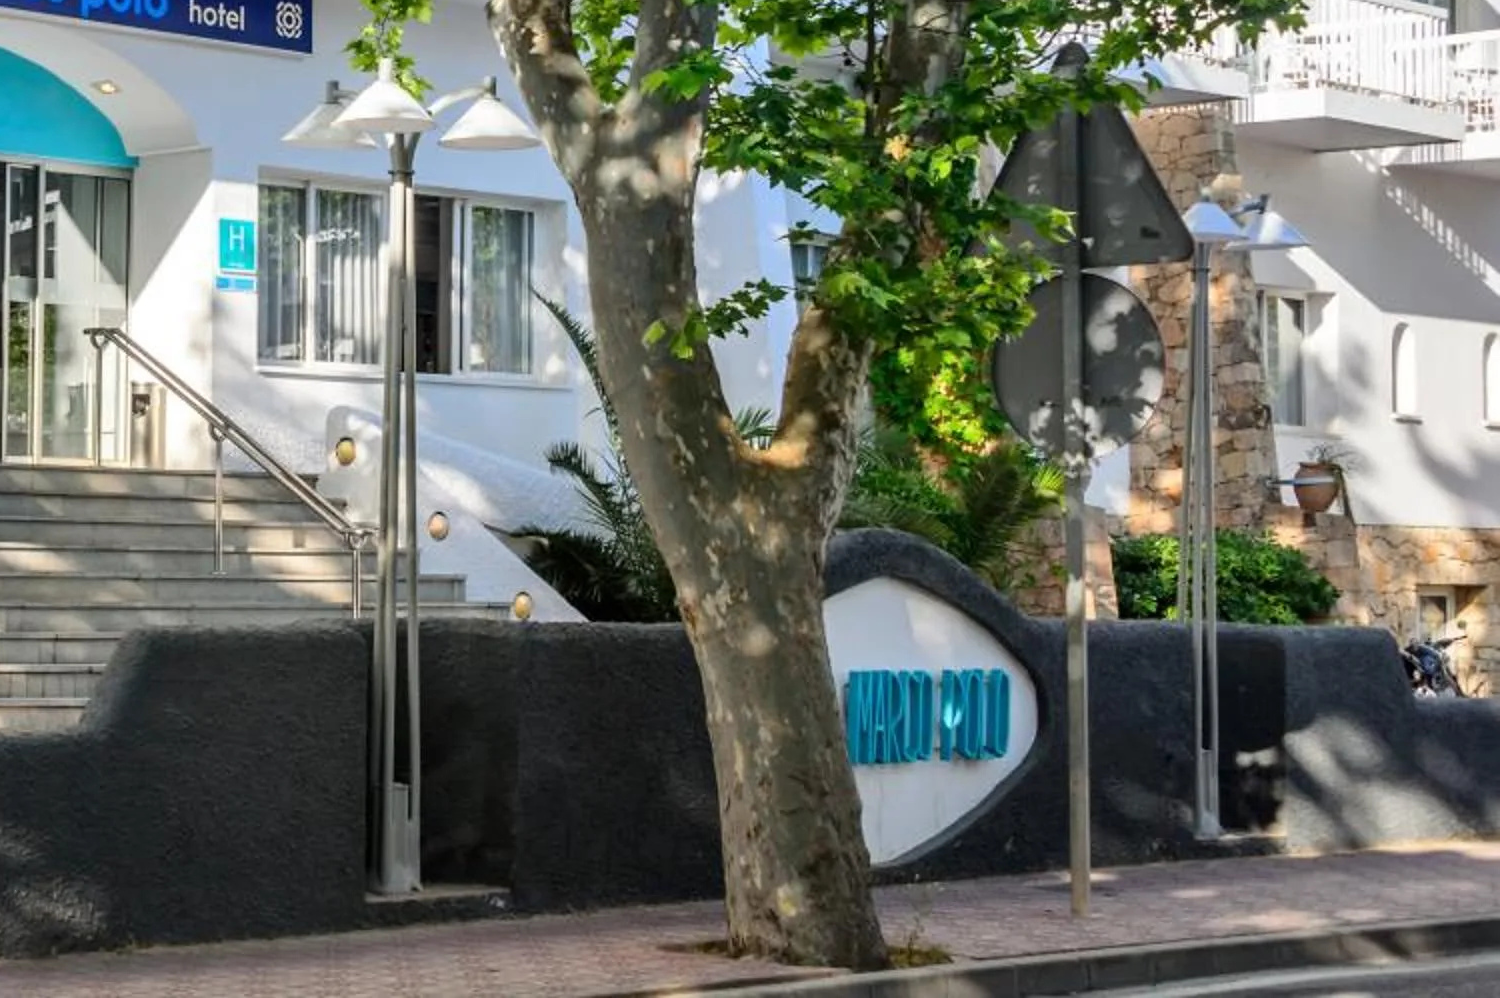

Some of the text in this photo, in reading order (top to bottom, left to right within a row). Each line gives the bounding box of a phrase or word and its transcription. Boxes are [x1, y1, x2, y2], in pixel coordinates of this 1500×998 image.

[229, 224, 245, 251] H
[847, 668, 1011, 764] MARCO POLO
